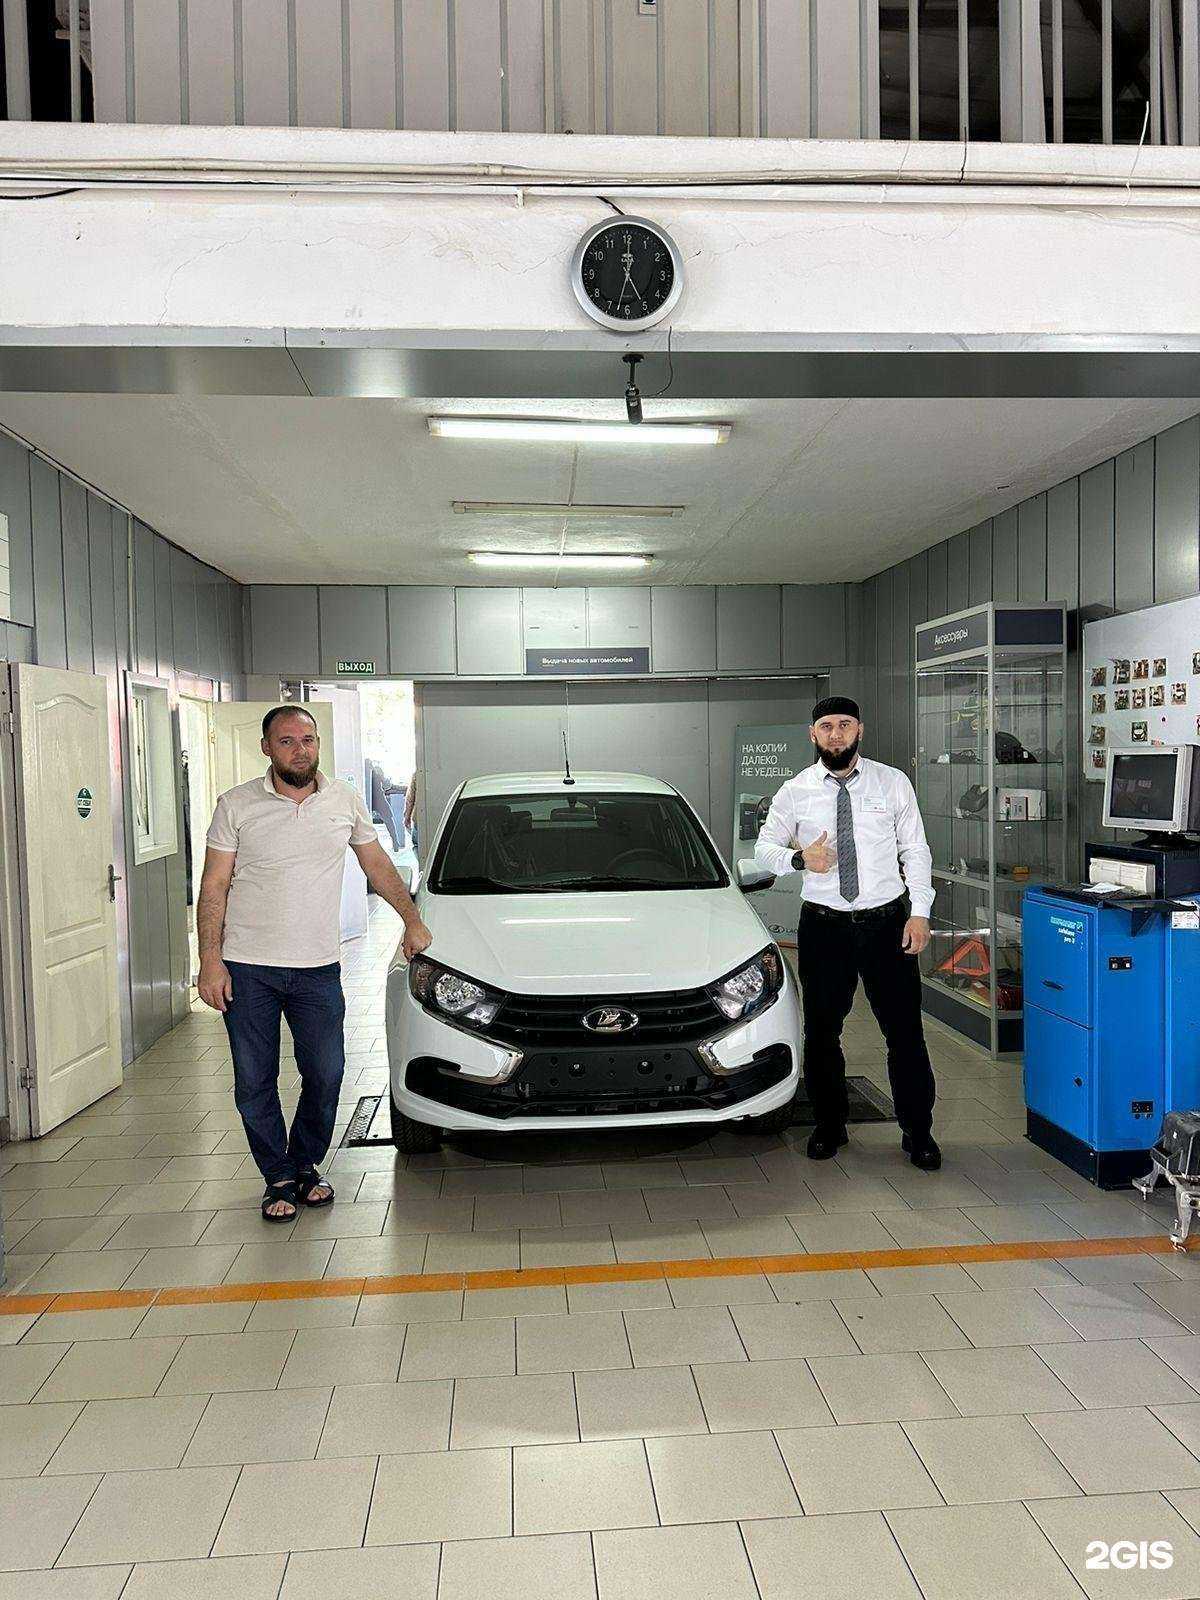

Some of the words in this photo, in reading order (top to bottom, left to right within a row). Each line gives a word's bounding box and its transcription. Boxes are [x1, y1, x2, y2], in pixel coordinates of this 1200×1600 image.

[605, 240, 614, 248] 11
[623, 234, 632, 245] 12
[643, 240, 648, 249] 1
[594, 251, 603, 261] 10
[654, 252, 660, 262] 2
[589, 269, 595, 280] 9
[660, 270, 666, 280] 3
[594, 288, 600, 298] 8
[654, 290, 660, 298] 4
[607, 300, 613, 309] 7
[624, 304, 631, 315] 6
[642, 301, 648, 310] 5
[934, 628, 968, 645] Аксессуары
[542, 657, 568, 665] Выдача
[589, 656, 634, 664] автомобилей
[338, 662, 373, 673] ВЫХОД
[742, 744, 755, 753] НА
[755, 743, 787, 753] КОПИИ
[741, 755, 778, 767] ДАЛЕКО
[741, 767, 754, 777] НЕ
[755, 767, 793, 778] УЕДЕШЬ
